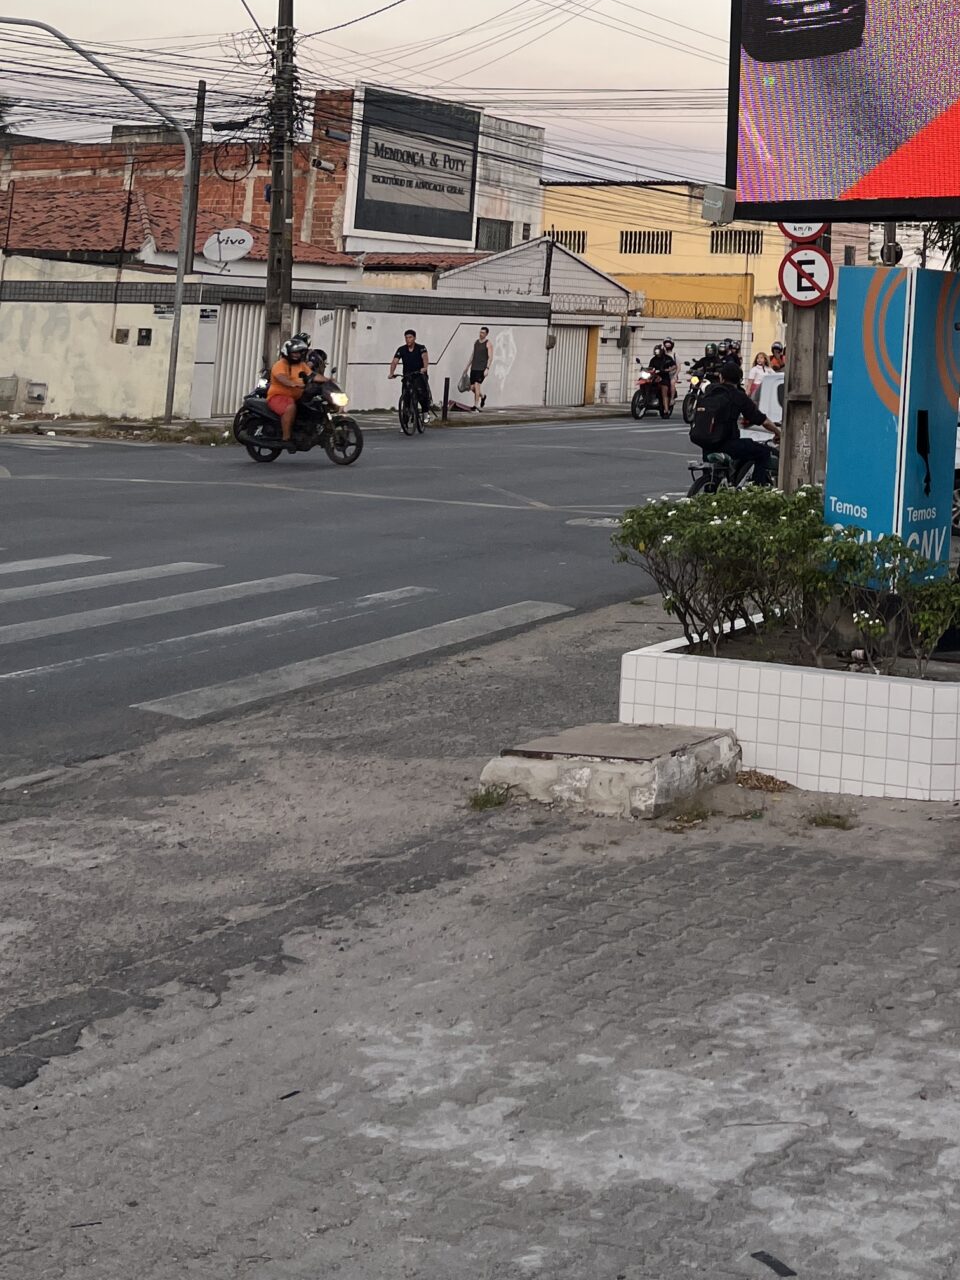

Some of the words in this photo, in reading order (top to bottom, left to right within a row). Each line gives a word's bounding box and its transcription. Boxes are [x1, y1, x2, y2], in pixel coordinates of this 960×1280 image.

[429, 151, 438, 167] &
[406, 179, 413, 188] DE
[793, 225, 813, 233] km/h
[218, 236, 246, 246] vivo
[797, 259, 815, 292] E
[829, 496, 868, 519] Temos
[907, 507, 937, 522] Temos
